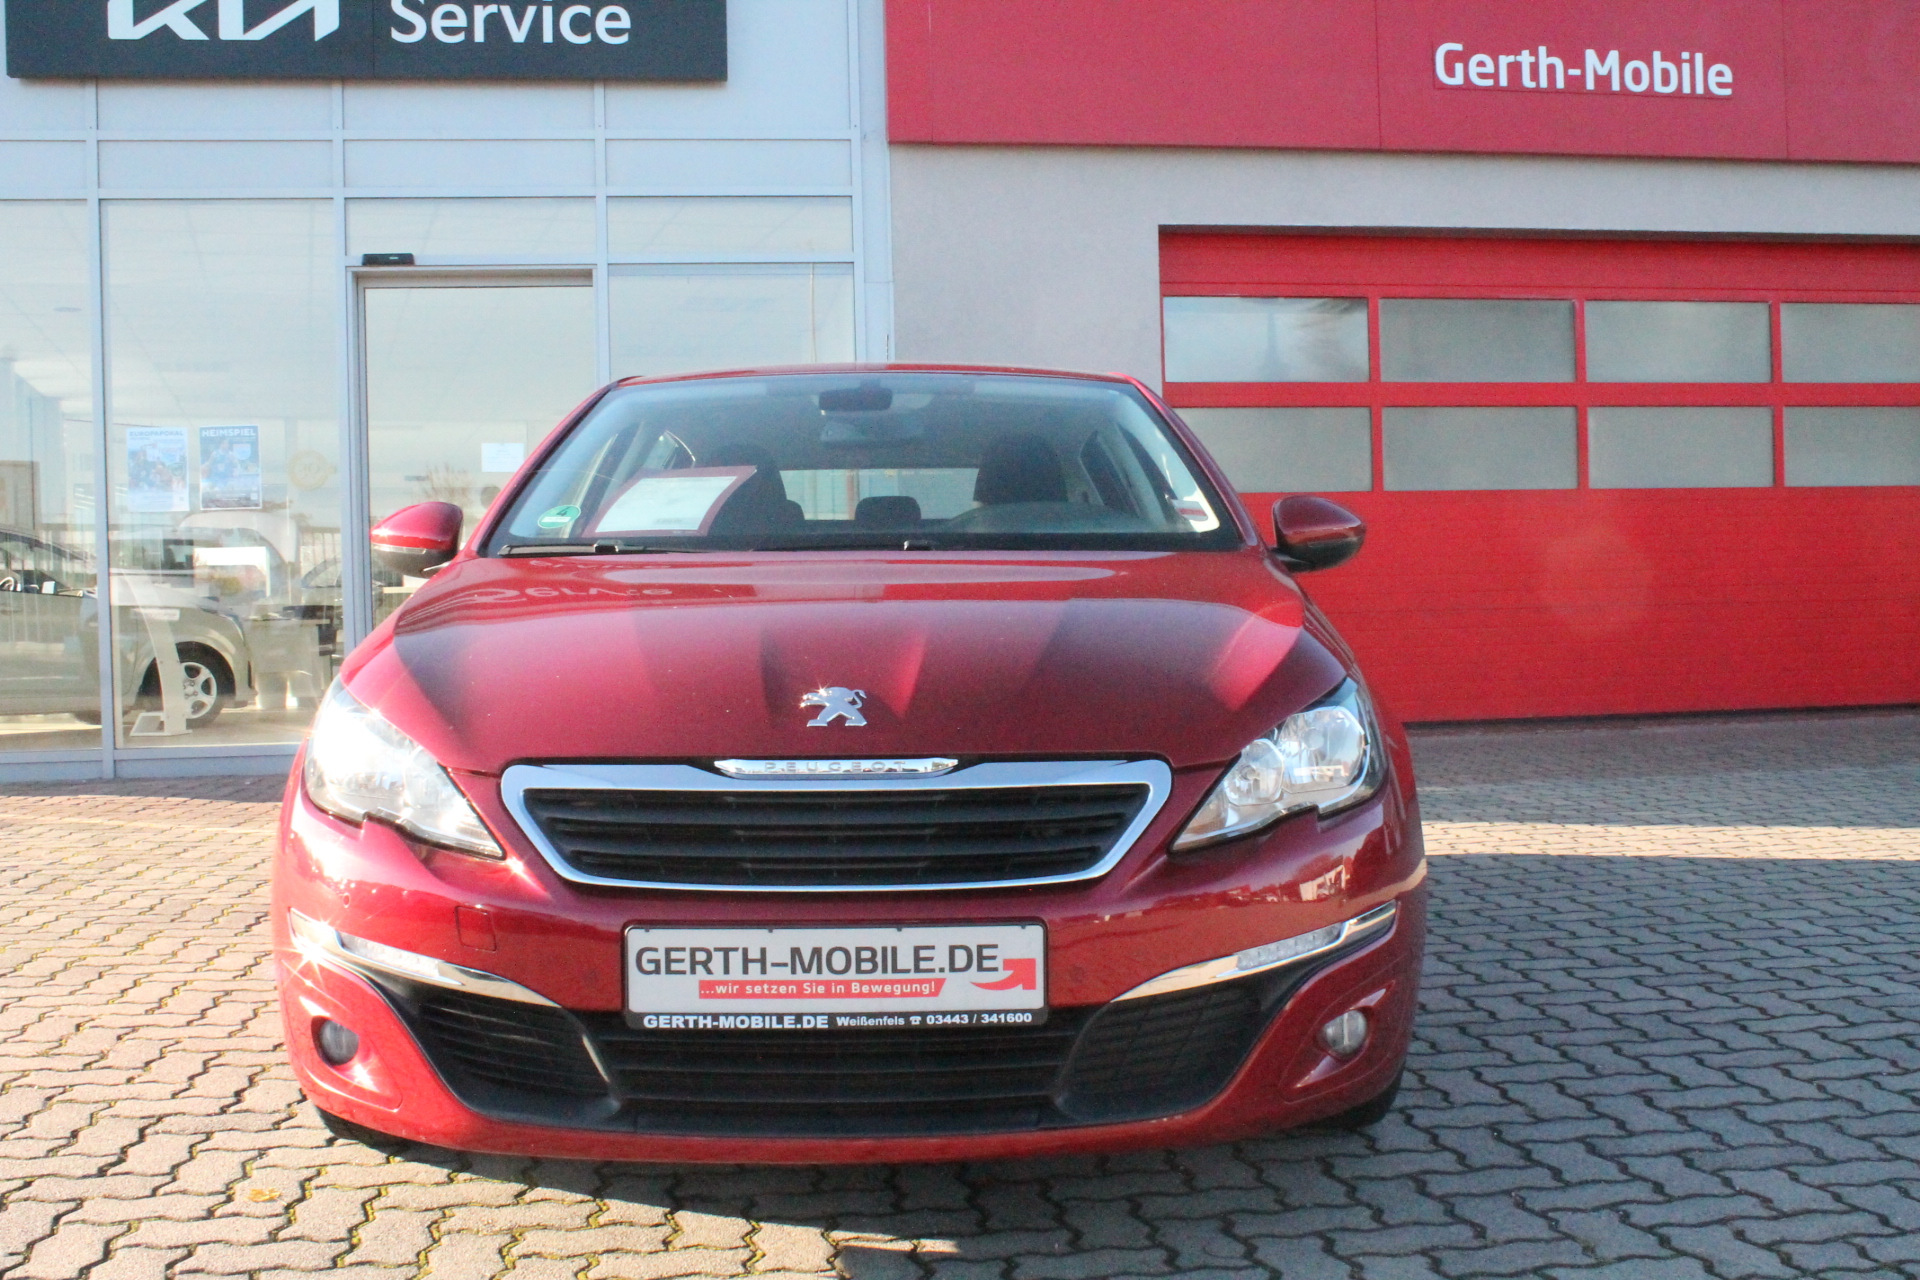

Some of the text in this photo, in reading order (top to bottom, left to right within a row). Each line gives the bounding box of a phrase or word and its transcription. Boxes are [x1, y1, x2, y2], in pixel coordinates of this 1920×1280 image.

[391, 0, 632, 44] Service
[1435, 42, 1733, 95] Gerth-Mobile
[201, 428, 256, 437] HEIMSPIEL
[765, 761, 906, 773] PEUGEOT
[635, 944, 998, 975] GERTH-MOBILE.DE
[701, 981, 935, 995] ...wir setzen Sie in Bewegung!
[643, 1015, 829, 1029] GERTH-MOBILE.DE
[836, 1016, 905, 1026] Weißenfels
[926, 1014, 969, 1024] 03443
[981, 1013, 1032, 1023] 341600
